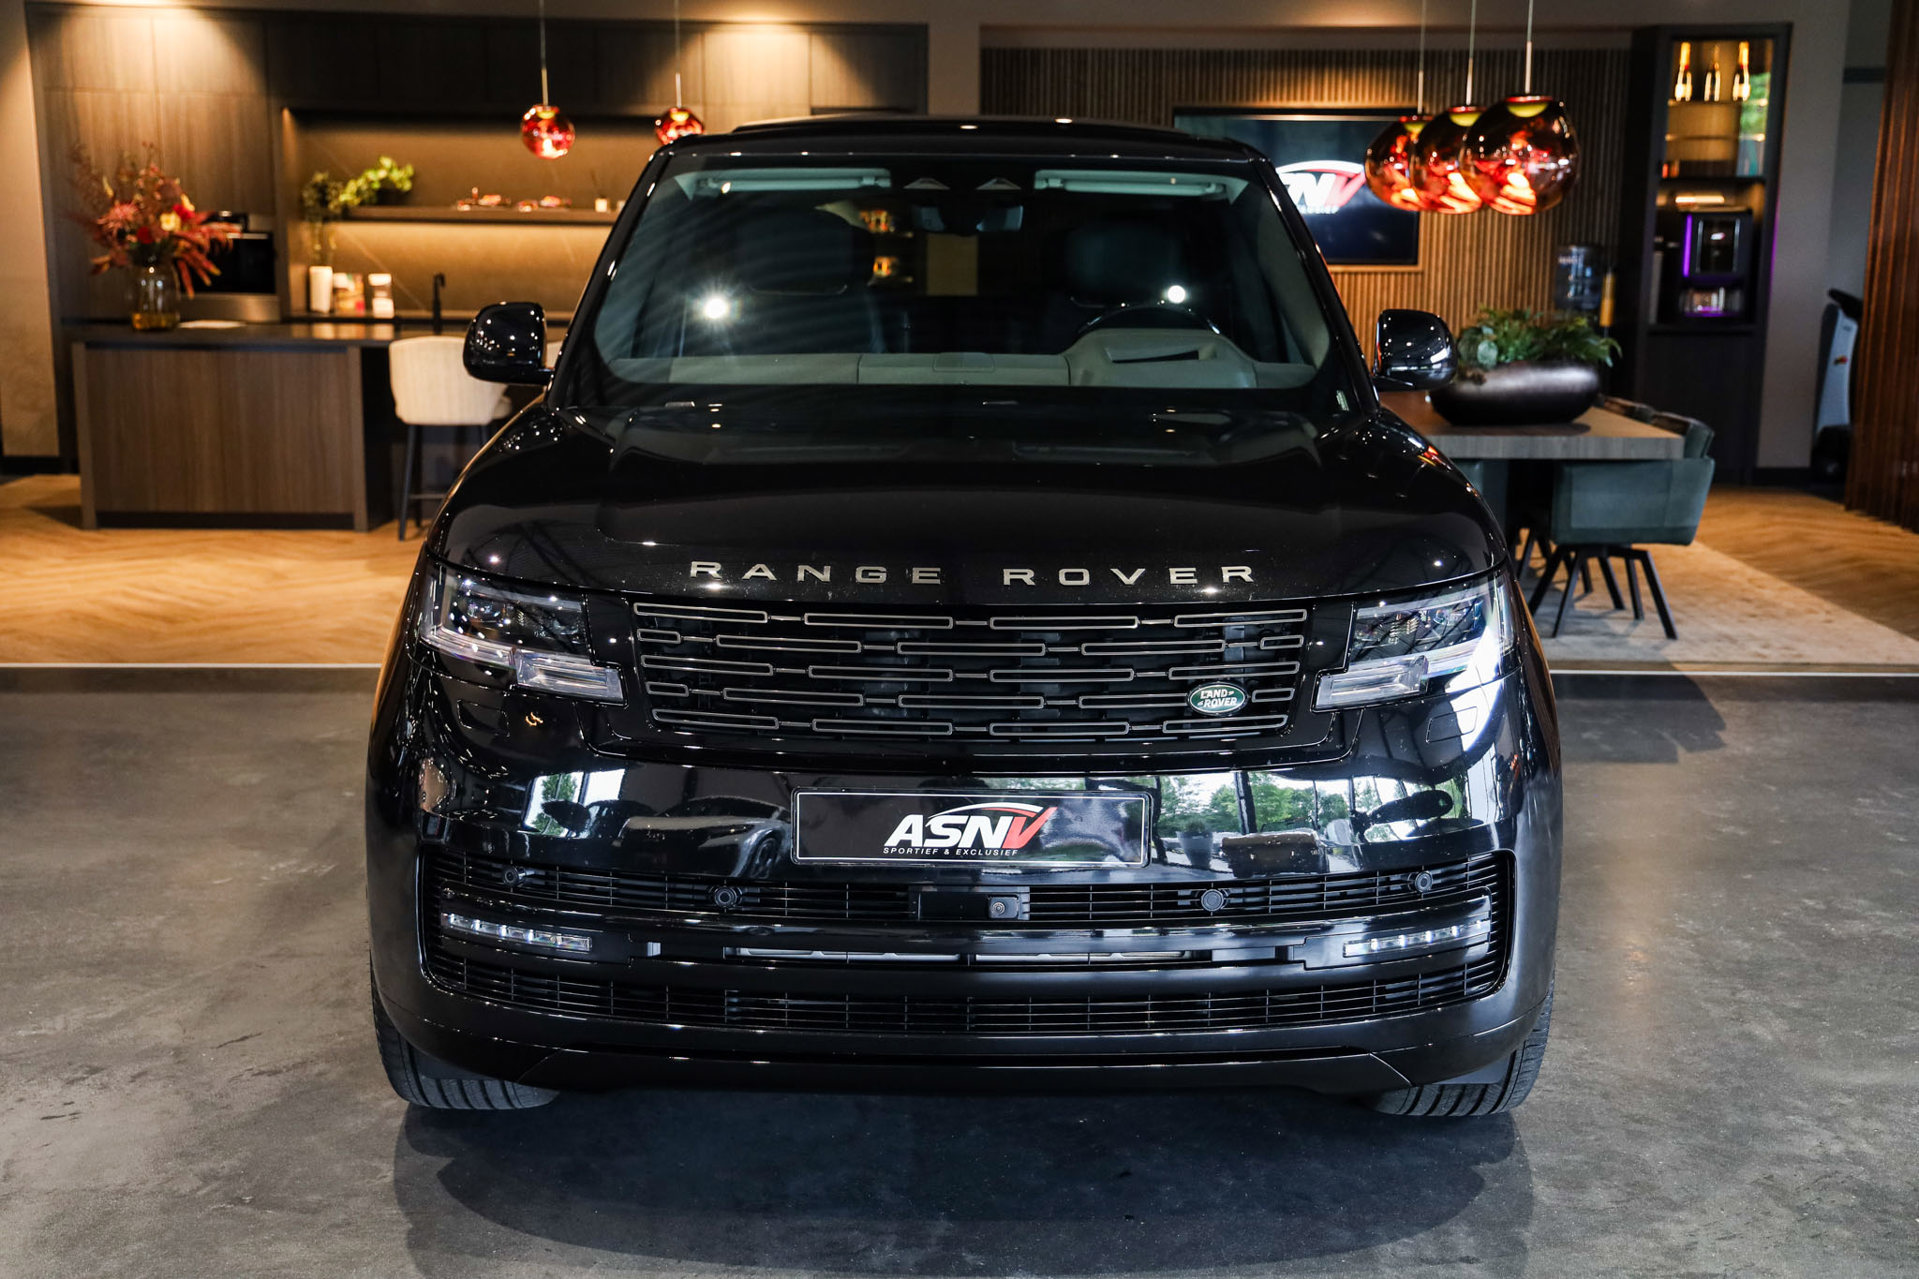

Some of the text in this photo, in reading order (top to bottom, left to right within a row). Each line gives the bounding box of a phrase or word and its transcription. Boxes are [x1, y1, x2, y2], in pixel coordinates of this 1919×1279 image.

[1278, 166, 1366, 208] NV
[690, 561, 1254, 586] RANGE ROVER
[1200, 689, 1228, 699] LAND
[1203, 697, 1237, 708] ROVER
[884, 806, 1058, 849] ASNV
[883, 847, 939, 855] SPORTIEF
[956, 848, 1018, 857] EXCLUSIEF
